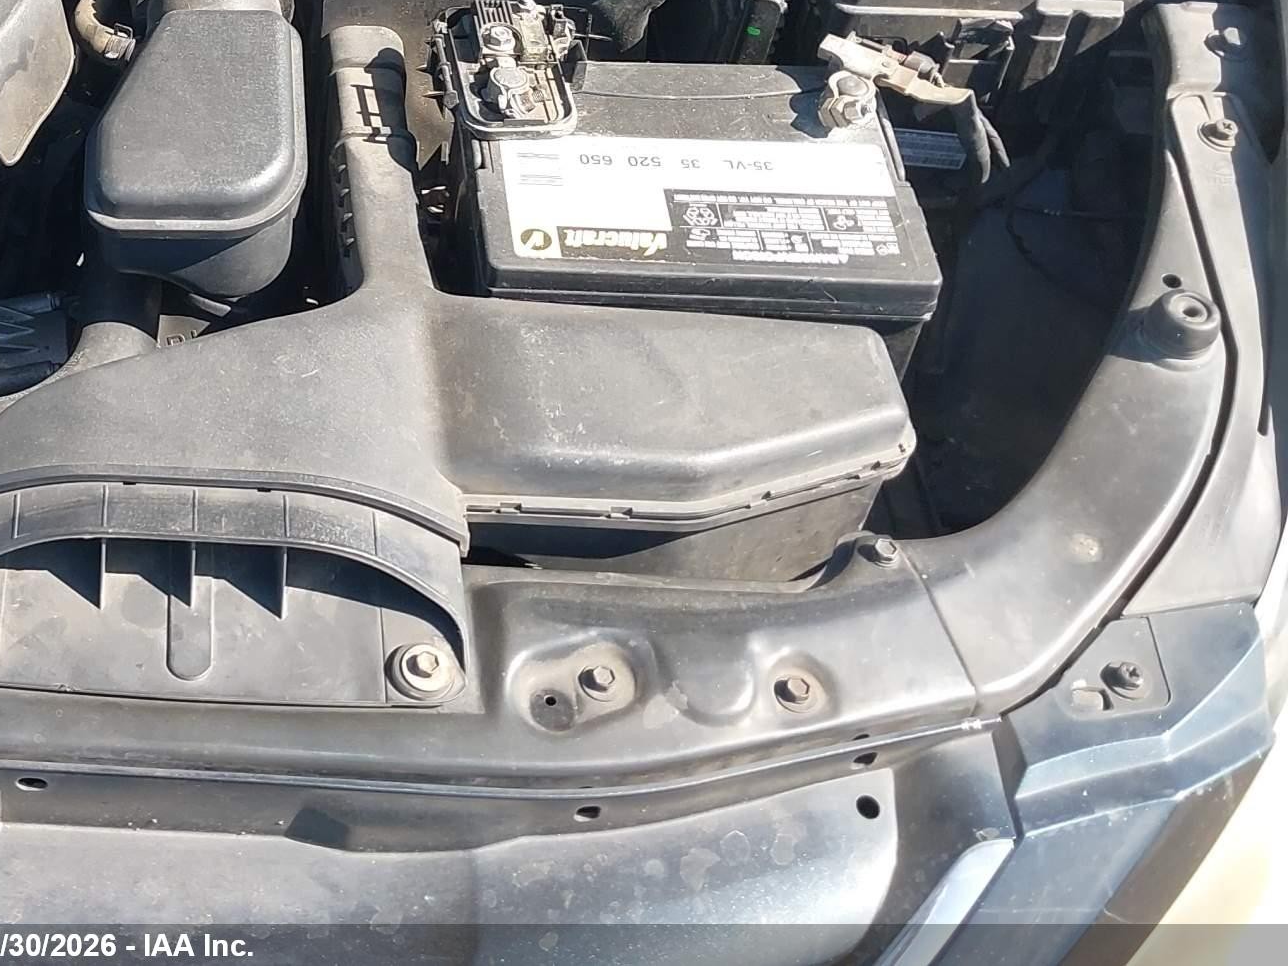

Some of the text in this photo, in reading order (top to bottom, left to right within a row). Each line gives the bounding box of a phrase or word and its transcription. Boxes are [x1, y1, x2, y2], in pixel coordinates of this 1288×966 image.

[579, 153, 774, 171] 35-VL 35 520 650
